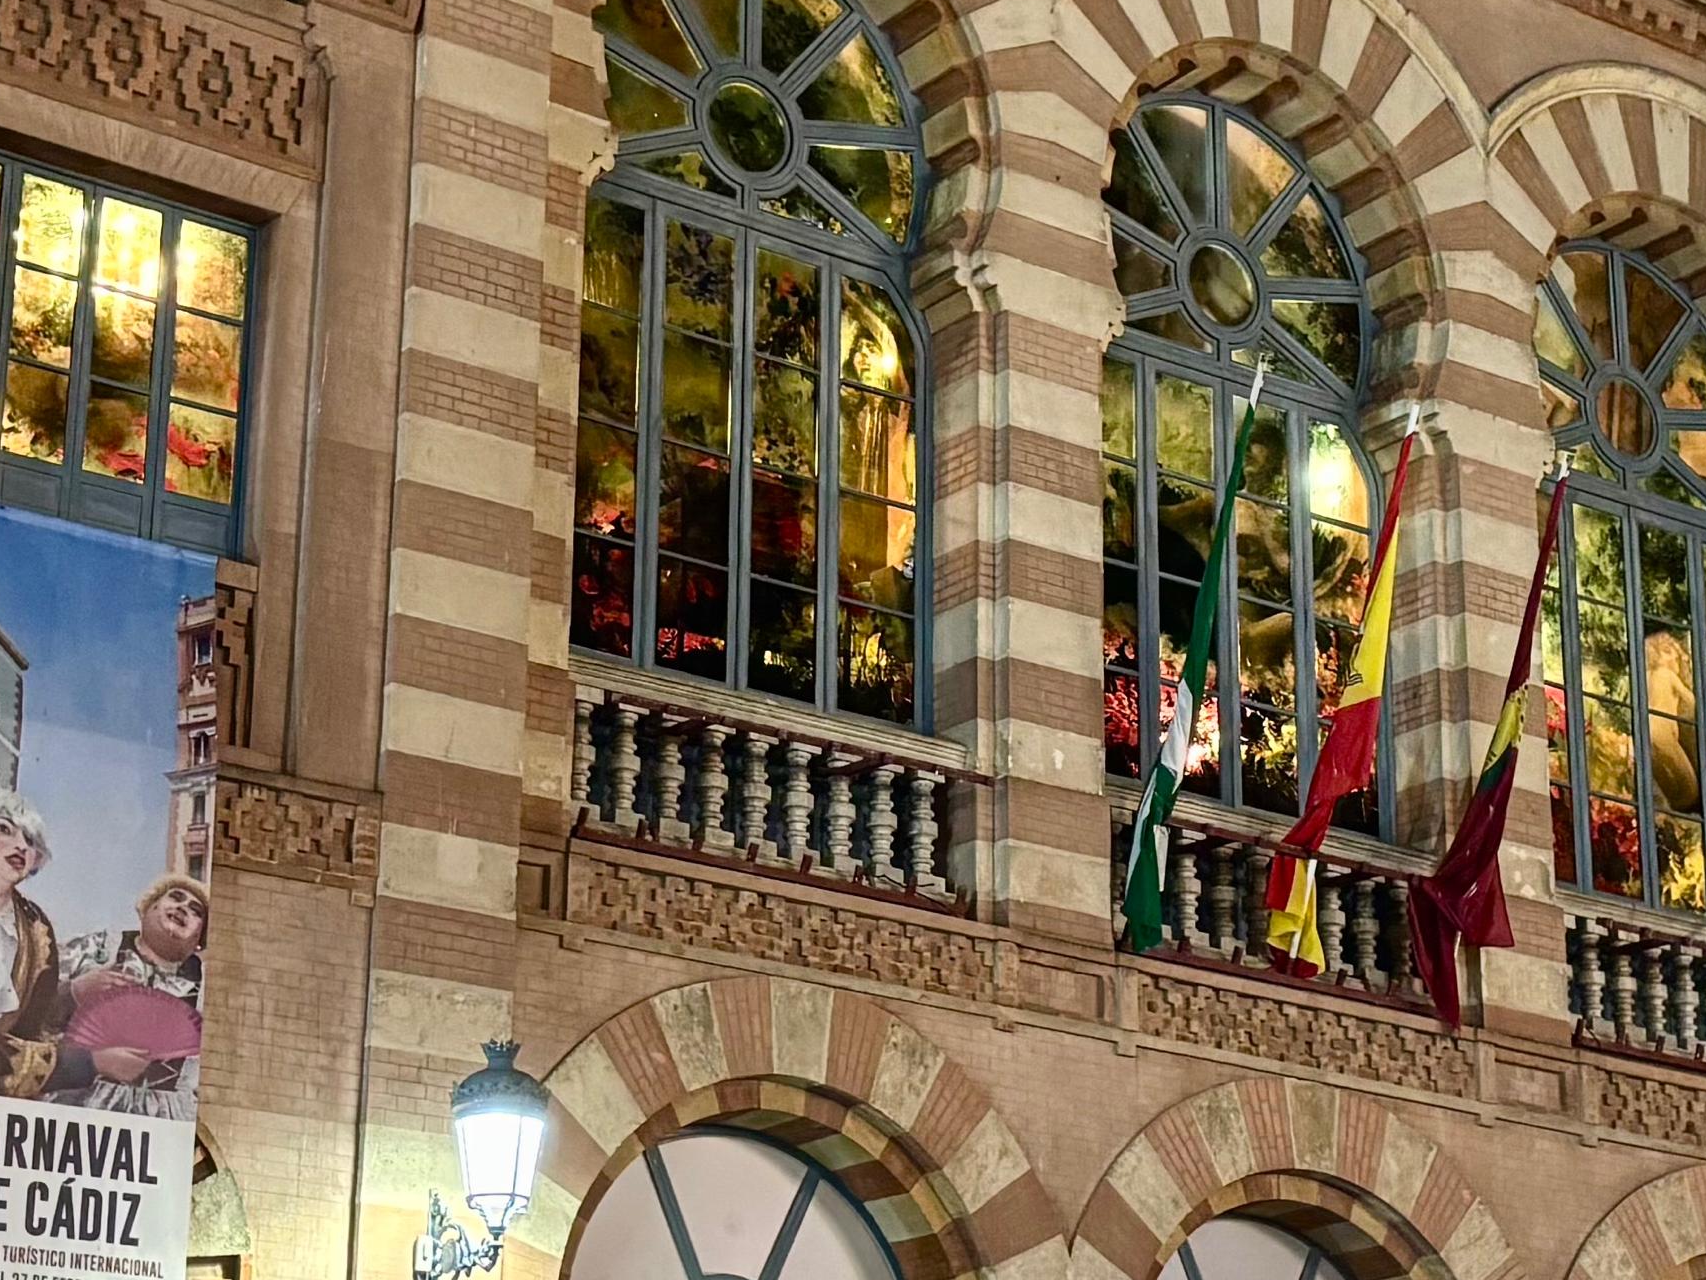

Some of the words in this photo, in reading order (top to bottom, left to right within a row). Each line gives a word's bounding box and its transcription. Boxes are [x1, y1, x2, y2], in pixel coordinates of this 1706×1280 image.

[25, 1178, 142, 1246] CÁDIZ
[3, 1243, 66, 1269] TURÍSTICO
[70, 1252, 164, 1279] INTERNACIONAL
